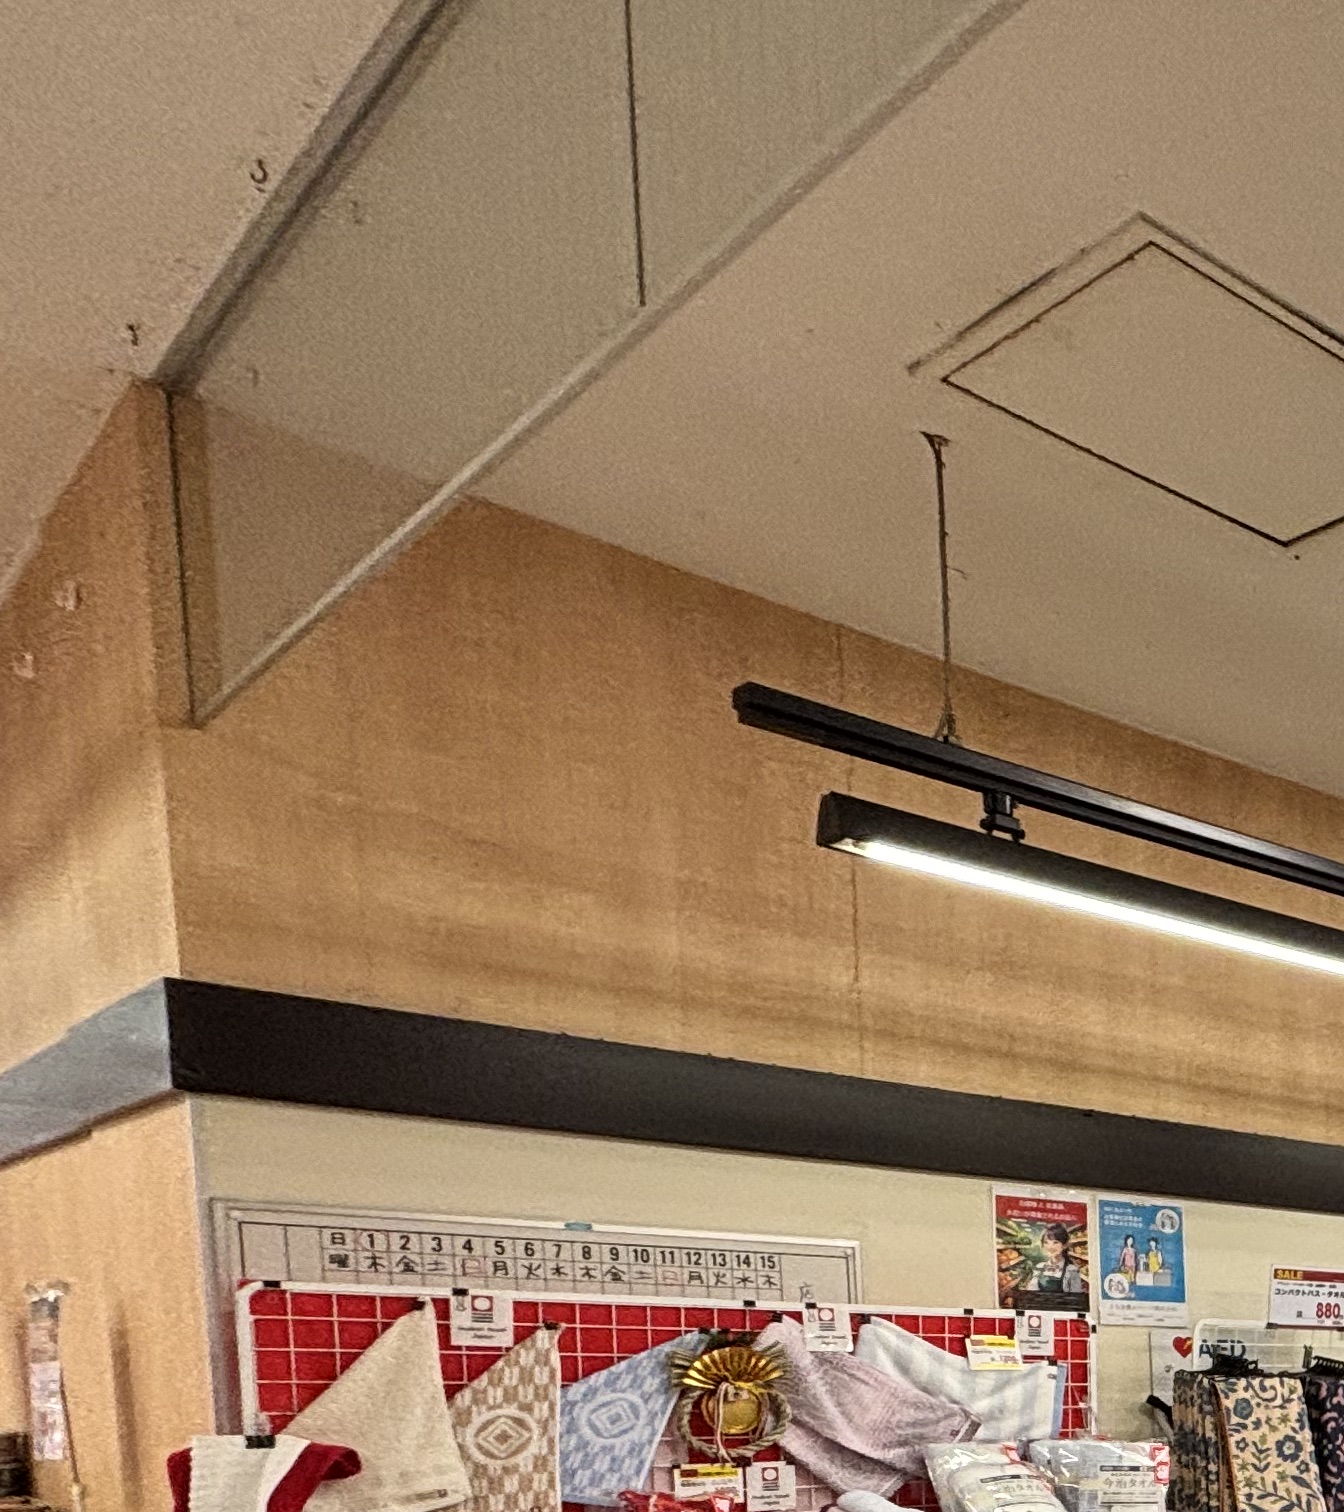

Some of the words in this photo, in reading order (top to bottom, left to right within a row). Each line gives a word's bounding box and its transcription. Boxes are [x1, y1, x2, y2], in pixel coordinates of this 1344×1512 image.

[331, 1233, 346, 1245] 日
[367, 1234, 374, 1248] 1
[400, 1236, 410, 1250] 2
[432, 1237, 442, 1251] 3
[462, 1239, 473, 1253] 4
[494, 1241, 505, 1255] 5
[524, 1243, 535, 1257] 6
[552, 1244, 561, 1258] 7
[582, 1246, 591, 1260] 8
[610, 1247, 619, 1261] 9
[633, 1249, 650, 1263] 10
[660, 1250, 675, 1264] 11
[686, 1252, 701, 1266] 12
[712, 1253, 727, 1267] 13
[736, 1254, 750, 1268] 14
[761, 1255, 776, 1269] 15
[365, 1254, 385, 1272] 木
[396, 1255, 418, 1272] 金
[493, 1261, 508, 1276] 月
[521, 1263, 541, 1278] 火
[579, 1266, 597, 1280] 木
[605, 1266, 625, 1281] 金
[688, 1271, 704, 1283] 月
[713, 1272, 727, 1285] 火
[762, 1275, 778, 1288] 木
[1276, 1270, 1304, 1280] SALE
[1316, 1302, 1341, 1319] 880
[1200, 1339, 1247, 1358] AED
